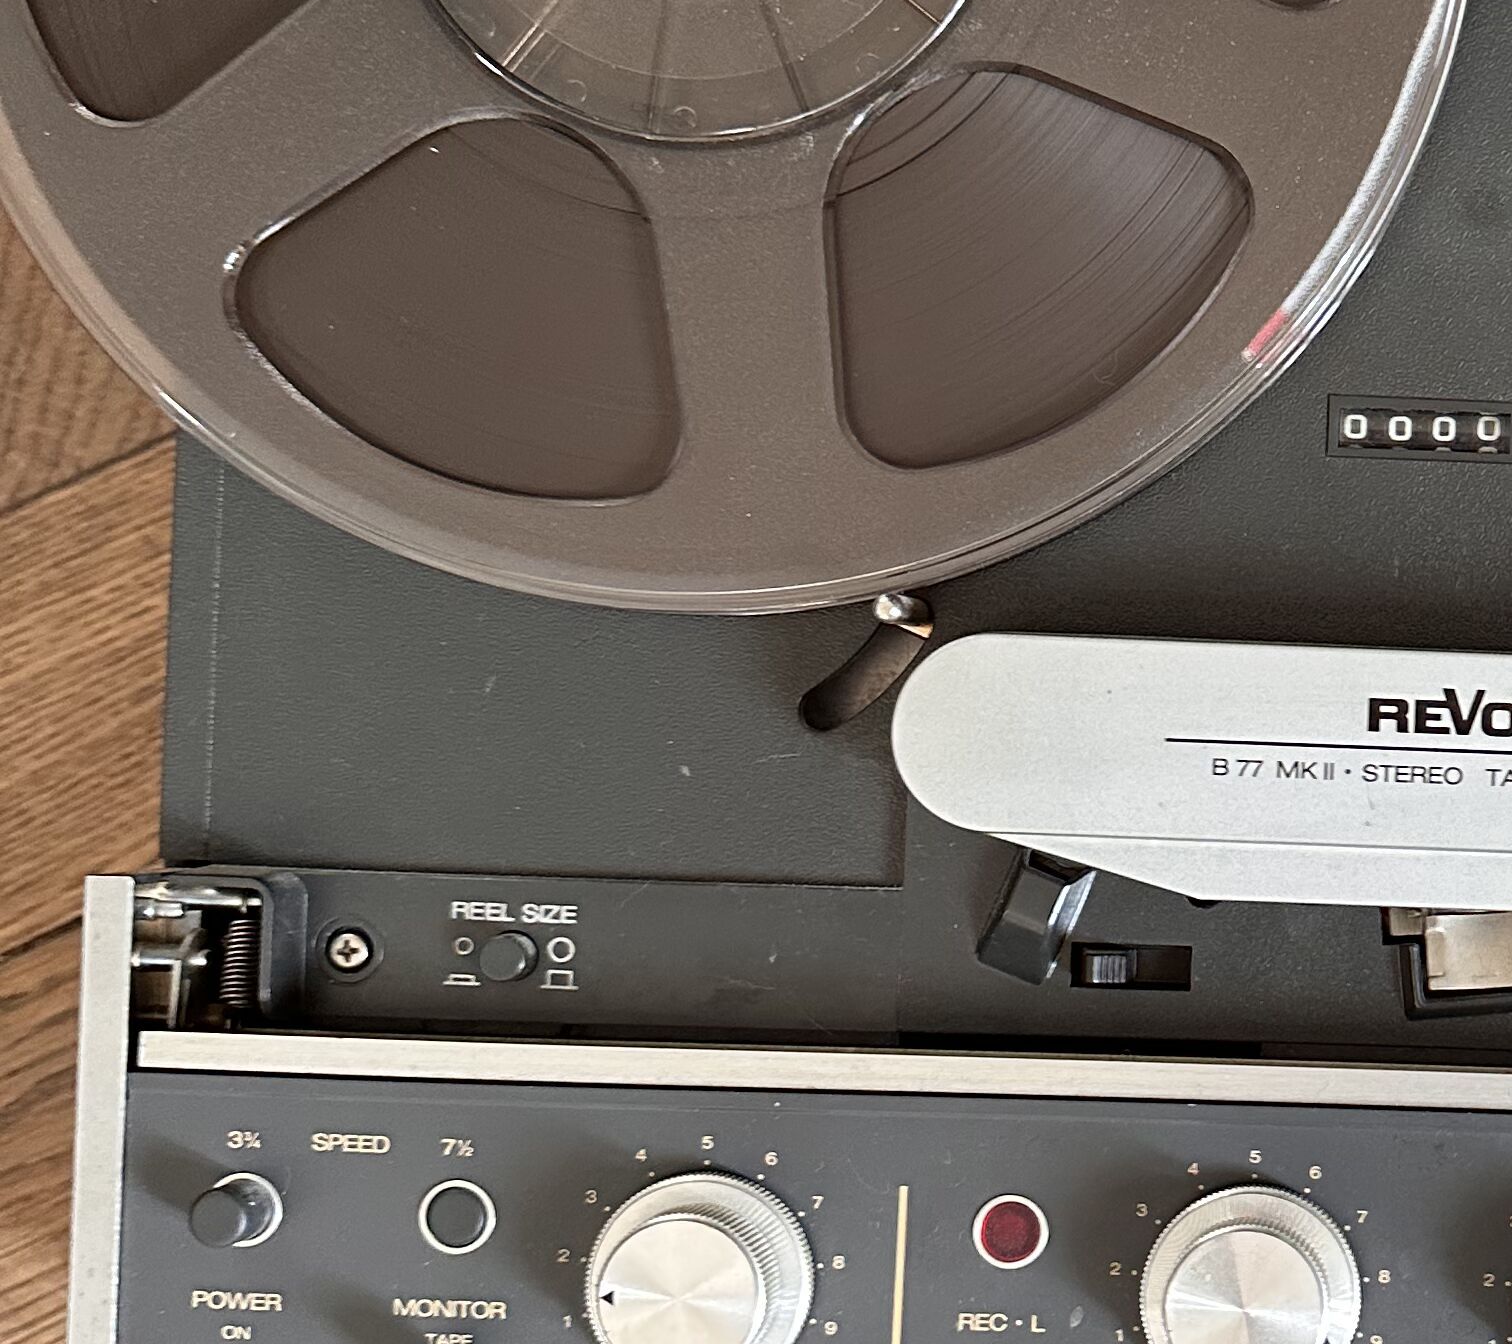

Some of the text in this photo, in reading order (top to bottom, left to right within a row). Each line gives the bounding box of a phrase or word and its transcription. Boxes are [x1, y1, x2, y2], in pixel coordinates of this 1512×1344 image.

[1361, 763, 1463, 786] STEREO
[451, 901, 578, 924] REEL SIZE
[310, 1132, 391, 1154] SPEED
[701, 1135, 715, 1150] 5
[635, 1148, 648, 1162] 4
[764, 1151, 779, 1166] 6
[1248, 1150, 1262, 1164] 5
[1187, 1162, 1199, 1175] 4
[1309, 1165, 1322, 1180] 6
[585, 1189, 598, 1204] 3
[811, 1195, 825, 1209] 7
[1135, 1203, 1148, 1217] 3
[1356, 1210, 1369, 1224] 7
[557, 1248, 571, 1263] 2
[831, 1255, 846, 1270] 8
[1109, 1261, 1122, 1276] 2
[1377, 1269, 1391, 1284] 8
[1483, 1273, 1495, 1287] 2
[190, 1290, 283, 1312] POWER
[392, 1298, 507, 1320] MONITOR
[563, 1315, 572, 1328] 1
[824, 1321, 838, 1336] 9
[956, 1312, 1009, 1332] REC
[220, 1325, 252, 1340] ON
[1115, 1329, 1124, 1342] 1
